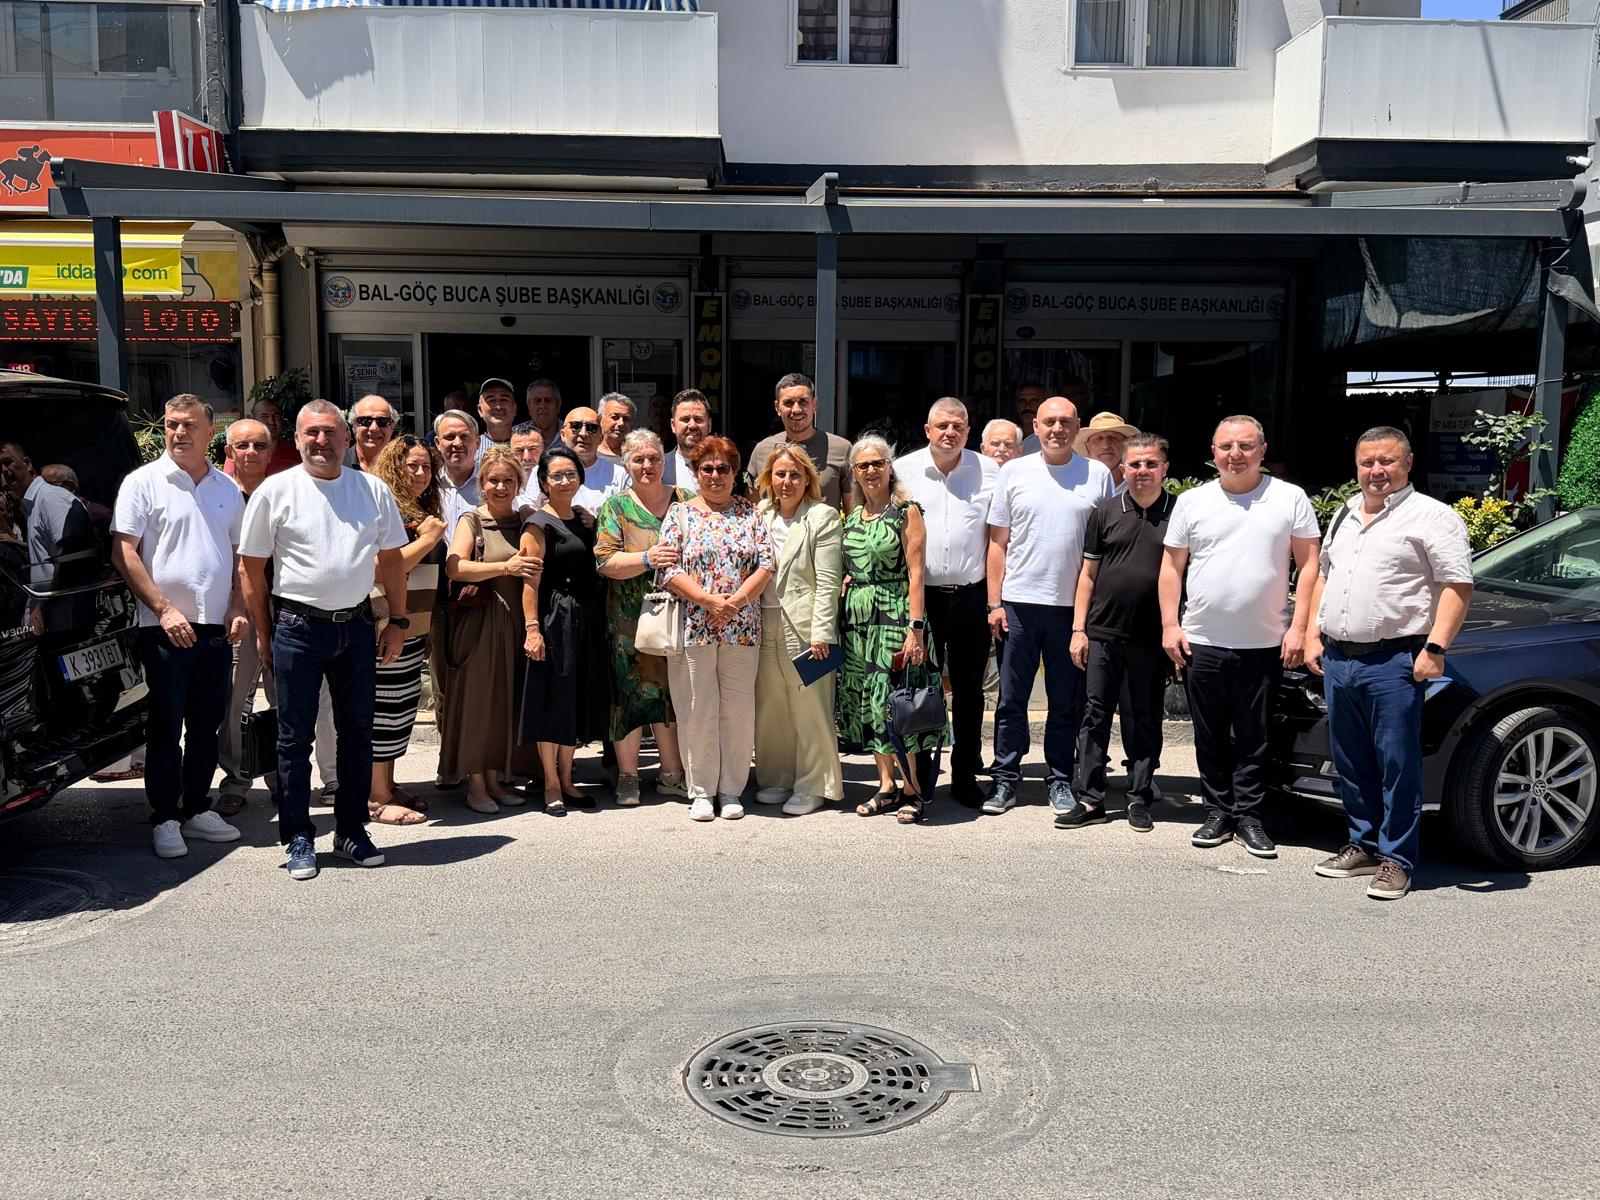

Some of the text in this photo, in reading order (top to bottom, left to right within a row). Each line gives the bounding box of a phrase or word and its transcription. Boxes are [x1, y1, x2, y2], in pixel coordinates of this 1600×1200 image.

[358, 281, 650, 309] BAL-GÖÇ BUCA ŞUBE BAŞKANLIĞI
[752, 293, 805, 309] BAL-GÖÇ
[841, 295, 871, 310] ŞUBE
[874, 294, 943, 311] BAŞKANLIĞI
[1031, 291, 1265, 315] BAL-GÖÇ BUCA ŞUBE BAŞKANLIĞI
[143, 308, 220, 331] LOTO
[68, 655, 81, 677] K
